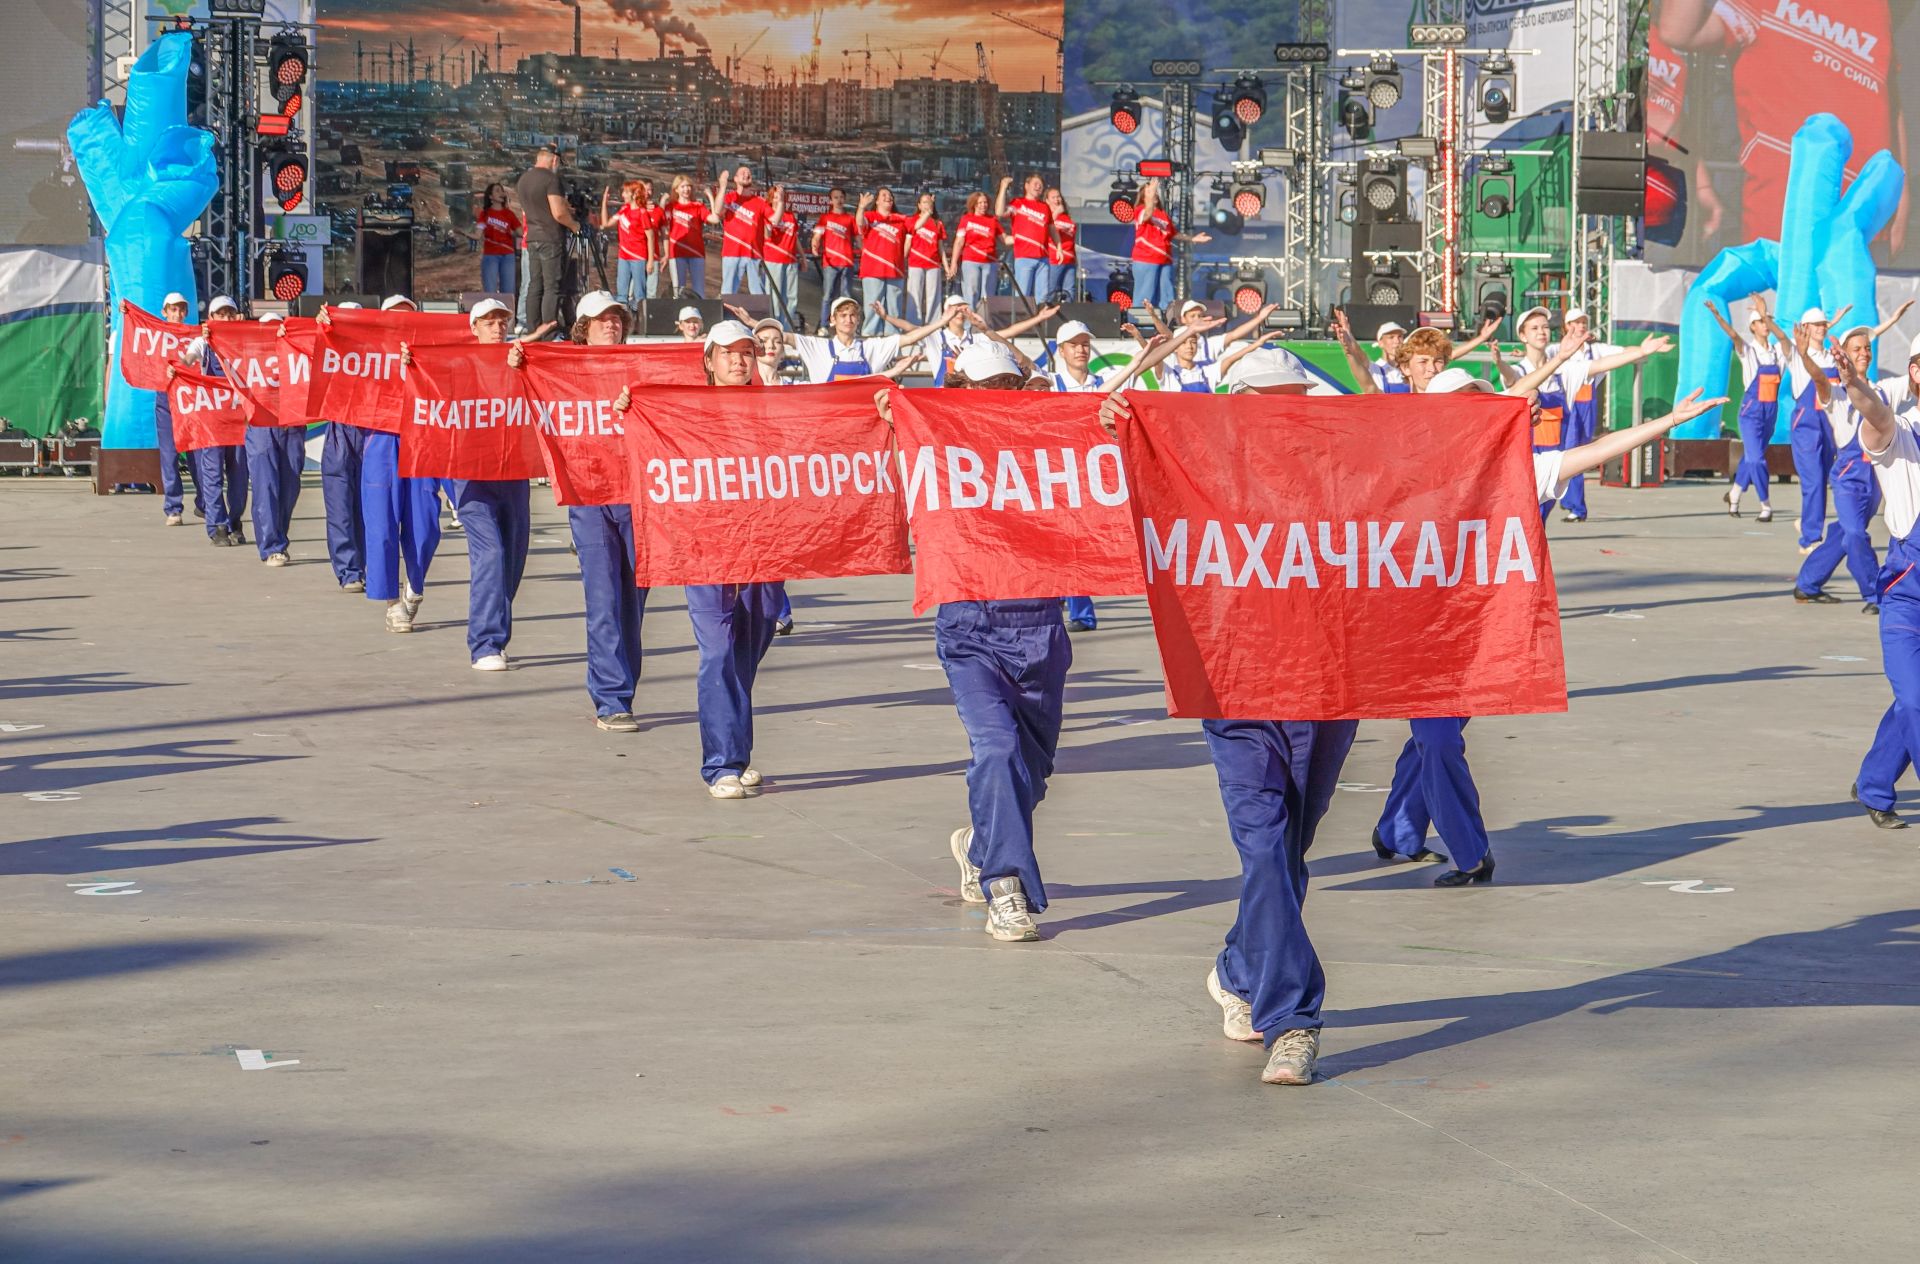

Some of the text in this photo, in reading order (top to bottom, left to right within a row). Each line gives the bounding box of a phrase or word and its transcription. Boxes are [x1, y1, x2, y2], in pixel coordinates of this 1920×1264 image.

[1774, 0, 1878, 63] KAMAZ
[1812, 50, 1879, 93] ЭТО СИЛА
[647, 450, 895, 504] ЗЕЛЕНОГОРСК
[898, 443, 1129, 524] ИВАНО
[1143, 516, 1538, 589] МАХАЧКАЛА
